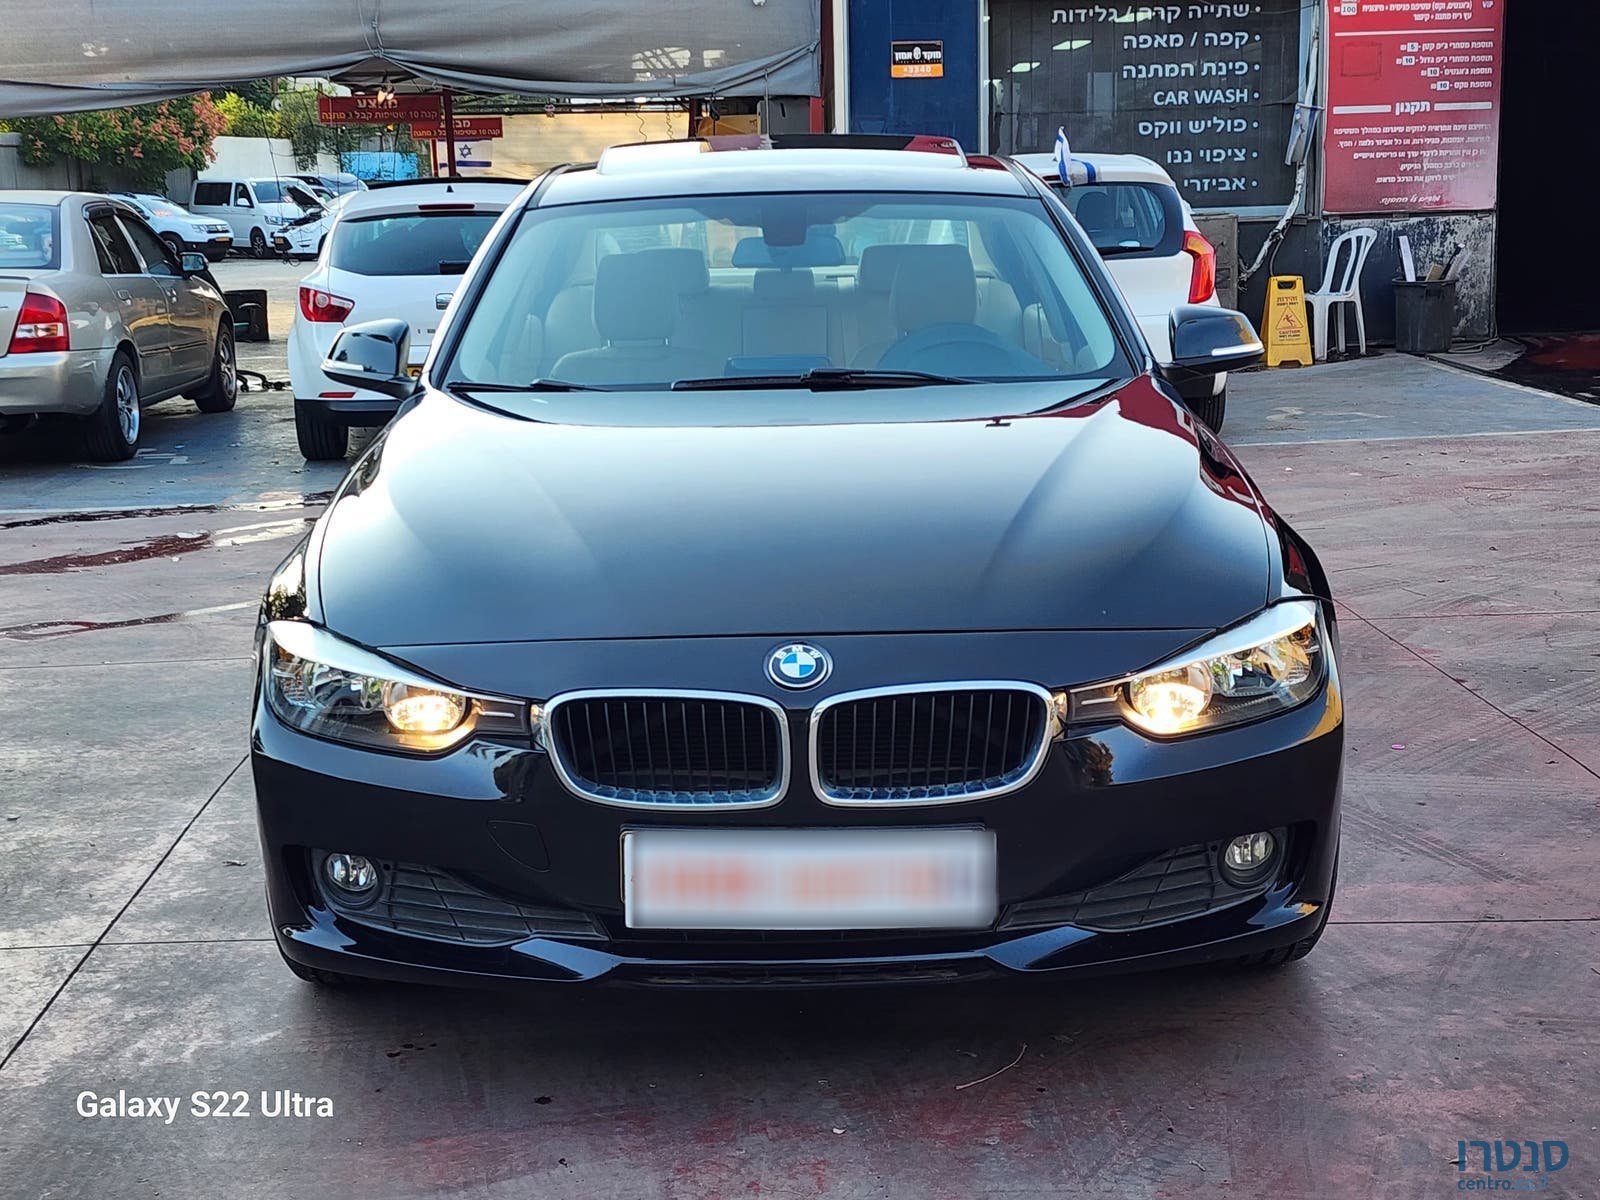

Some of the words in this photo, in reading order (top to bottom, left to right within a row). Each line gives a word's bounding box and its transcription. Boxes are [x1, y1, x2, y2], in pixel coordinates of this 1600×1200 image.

[1051, 5, 1118, 23] גלידות
[1188, 4, 1250, 19] שתייה
[1123, 34, 1184, 49] מאפה
[1190, 32, 1198, 47] /
[1204, 32, 1249, 49] קפה
[1123, 63, 1194, 79] המתנה
[1201, 61, 1249, 76] פינת
[1153, 90, 1189, 106] CAR
[1194, 88, 1248, 104] WASH
[321, 111, 346, 120] מתנה
[354, 111, 372, 120] קבל
[374, 111, 406, 119] שטיפות
[421, 111, 437, 119] קנה
[1395, 101, 1430, 115] תקנון
[1138, 121, 1181, 139] ווקס
[1188, 116, 1247, 134] פוליש
[1167, 150, 1192, 164] ננו
[1199, 148, 1246, 162] ציפוי
[1183, 178, 1246, 192] אביזרי
